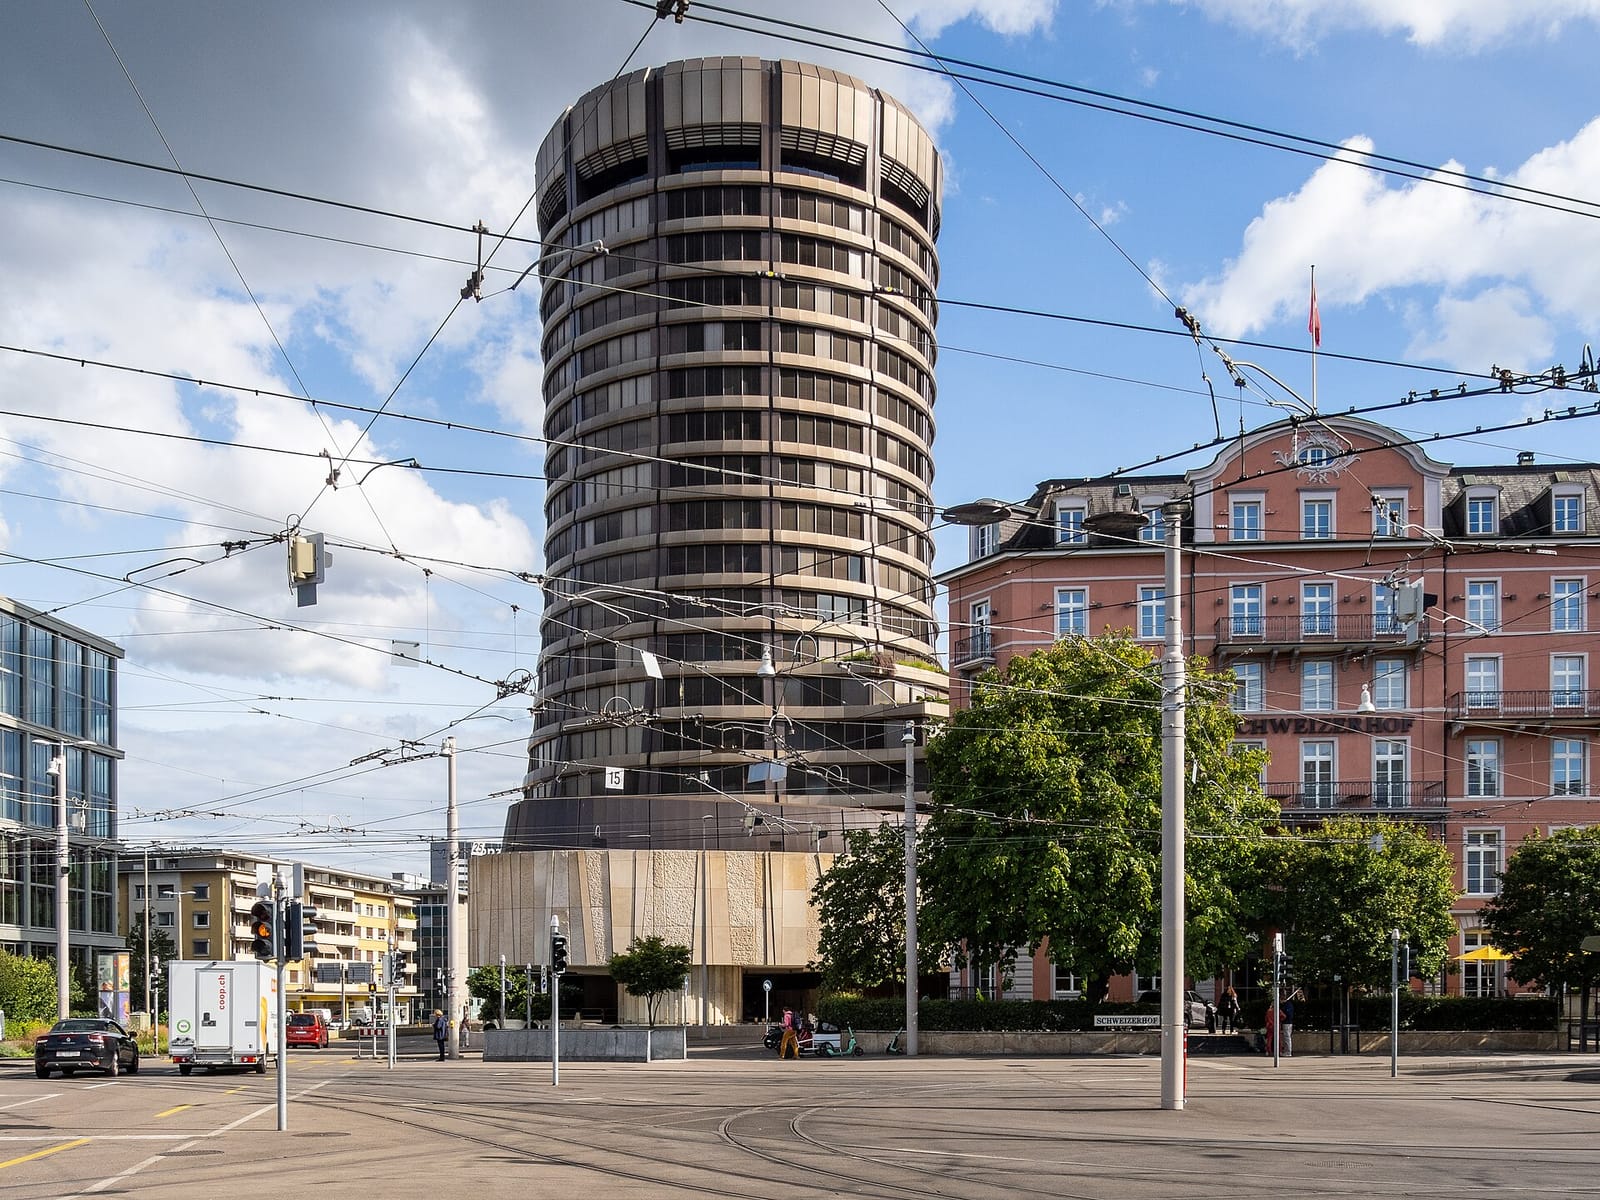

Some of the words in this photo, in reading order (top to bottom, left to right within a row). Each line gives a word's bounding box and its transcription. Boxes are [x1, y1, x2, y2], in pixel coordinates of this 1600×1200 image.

[1236, 717, 1414, 736] CHWEIZERHOF
[608, 771, 621, 785] 15
[472, 842, 483, 853] 25
[218, 974, 226, 1010] coop.ch
[1096, 1016, 1158, 1025] SCHWEIZERHOF
